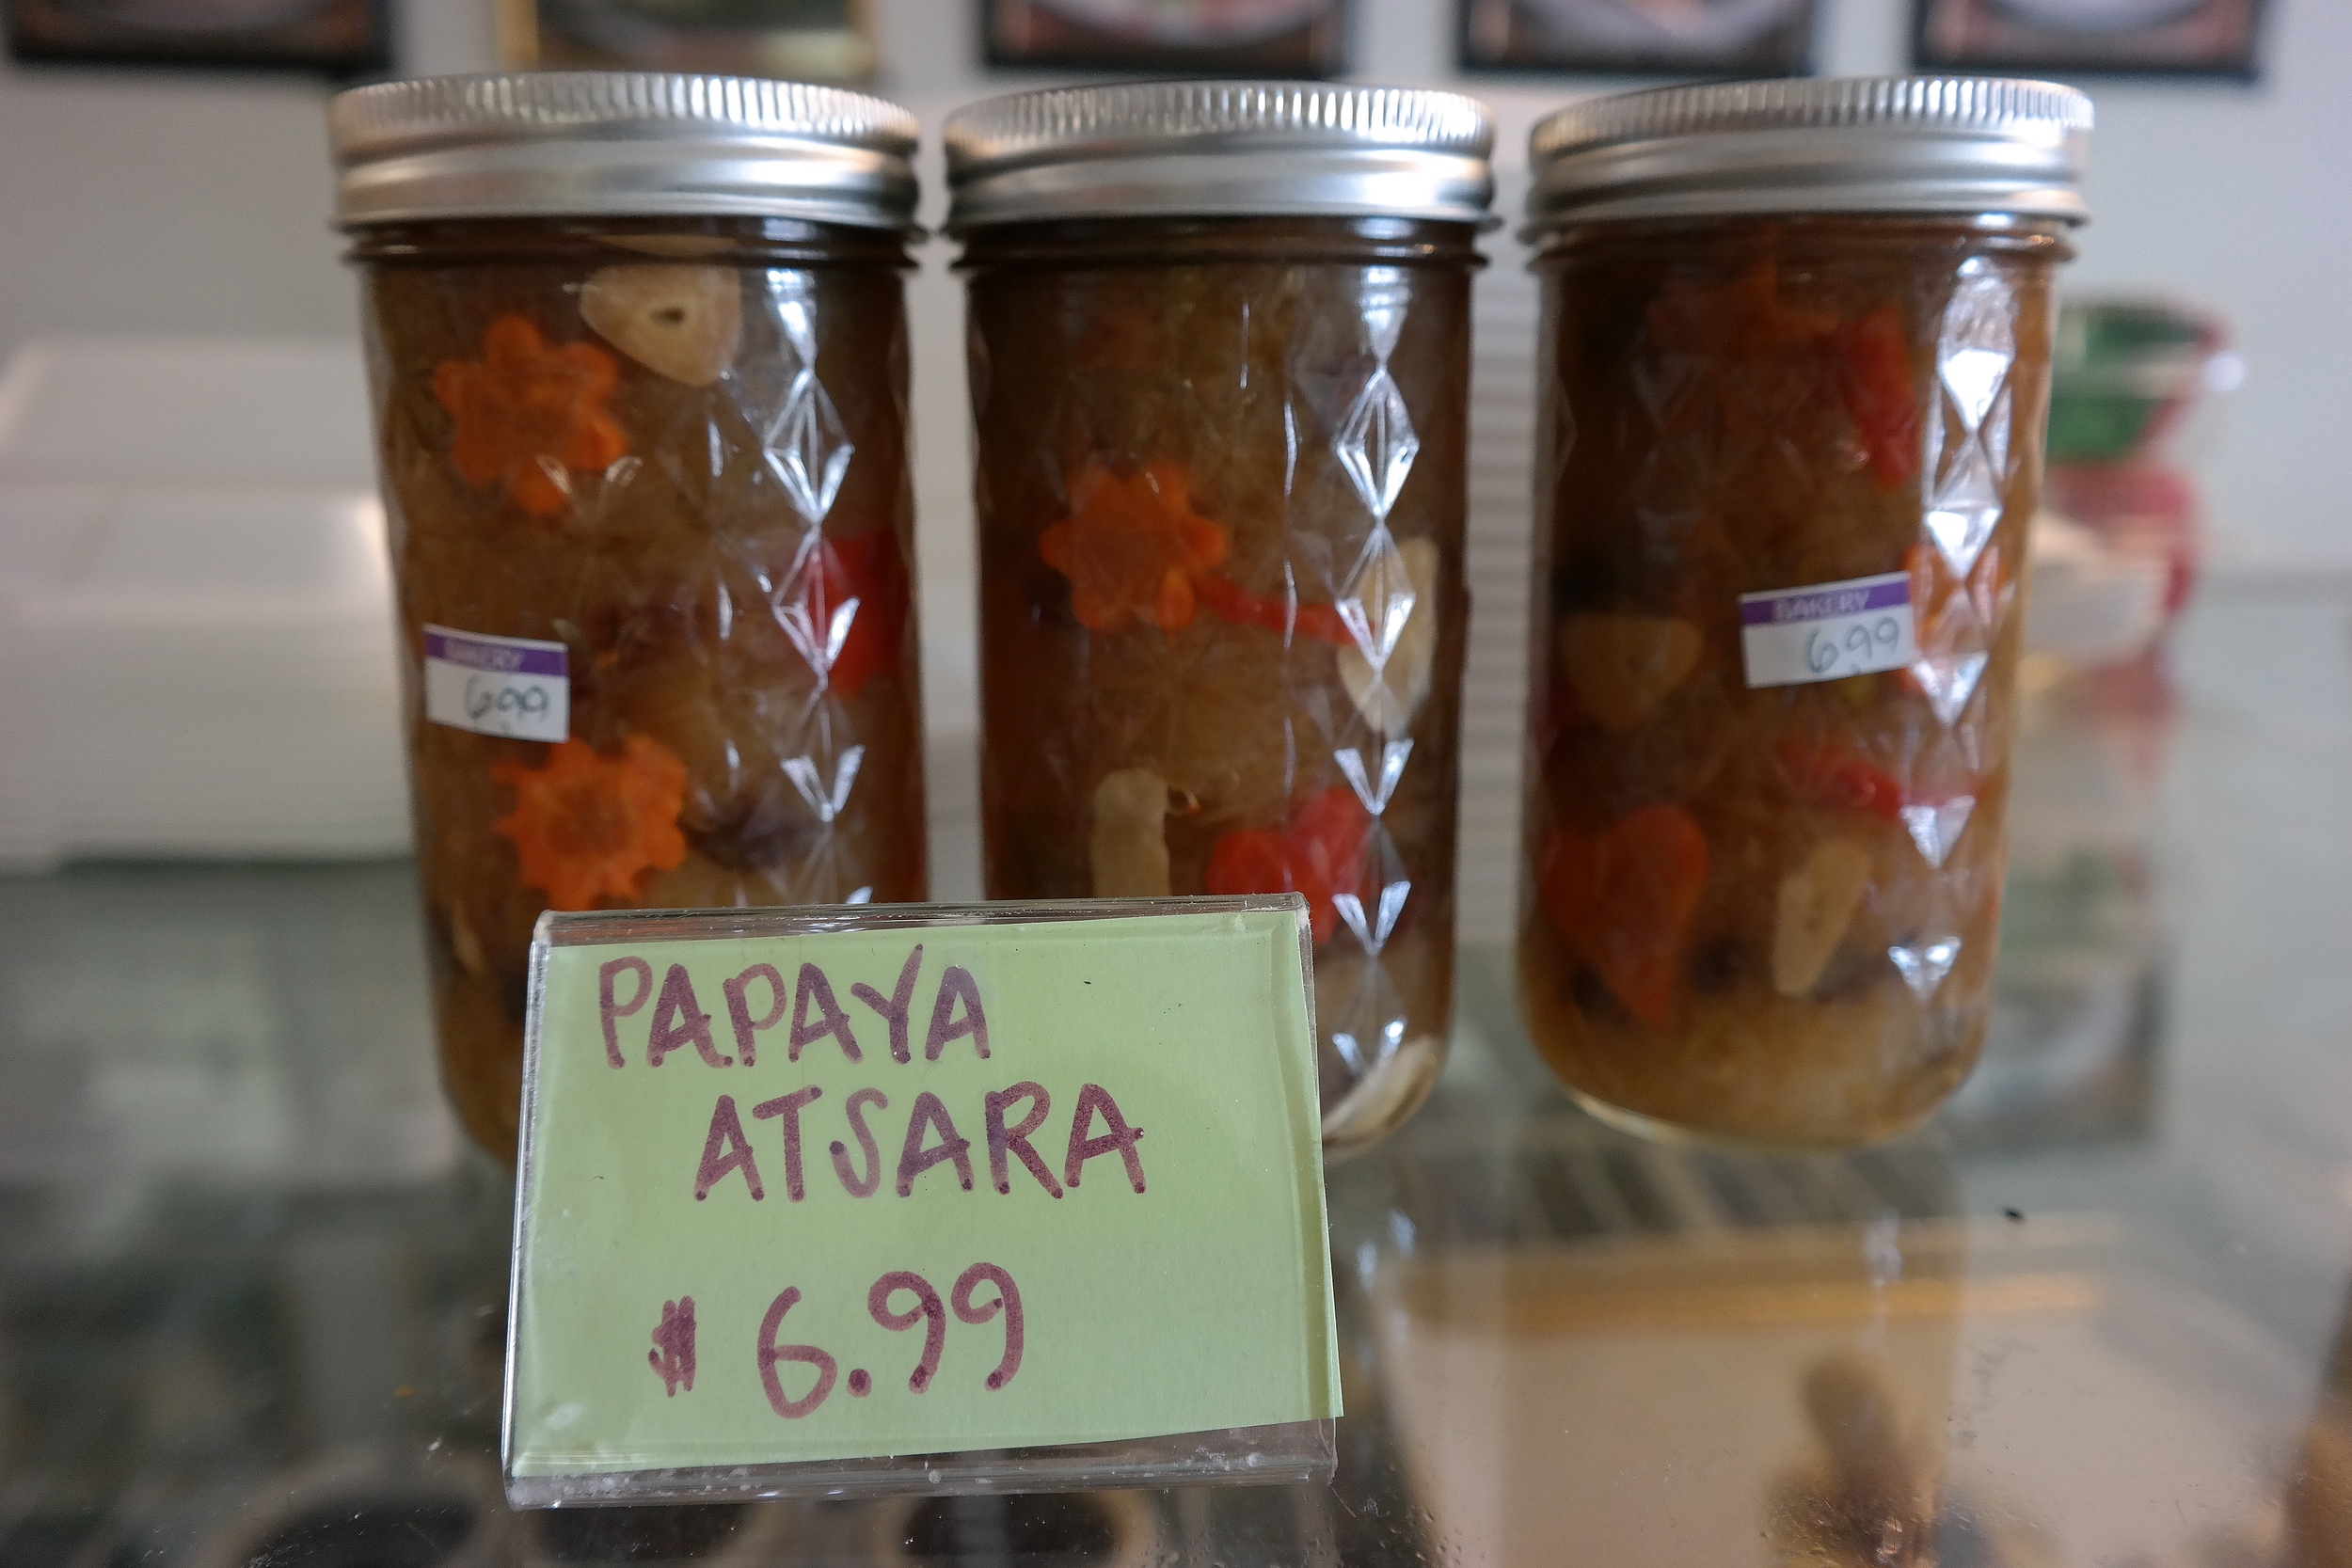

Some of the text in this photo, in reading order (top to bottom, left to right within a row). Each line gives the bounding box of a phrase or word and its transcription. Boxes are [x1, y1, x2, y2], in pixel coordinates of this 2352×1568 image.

[1772, 590, 1871, 621] BAKERY
[598, 943, 992, 1070] PAPAYA
[693, 1081, 1147, 1203] ATSARA
